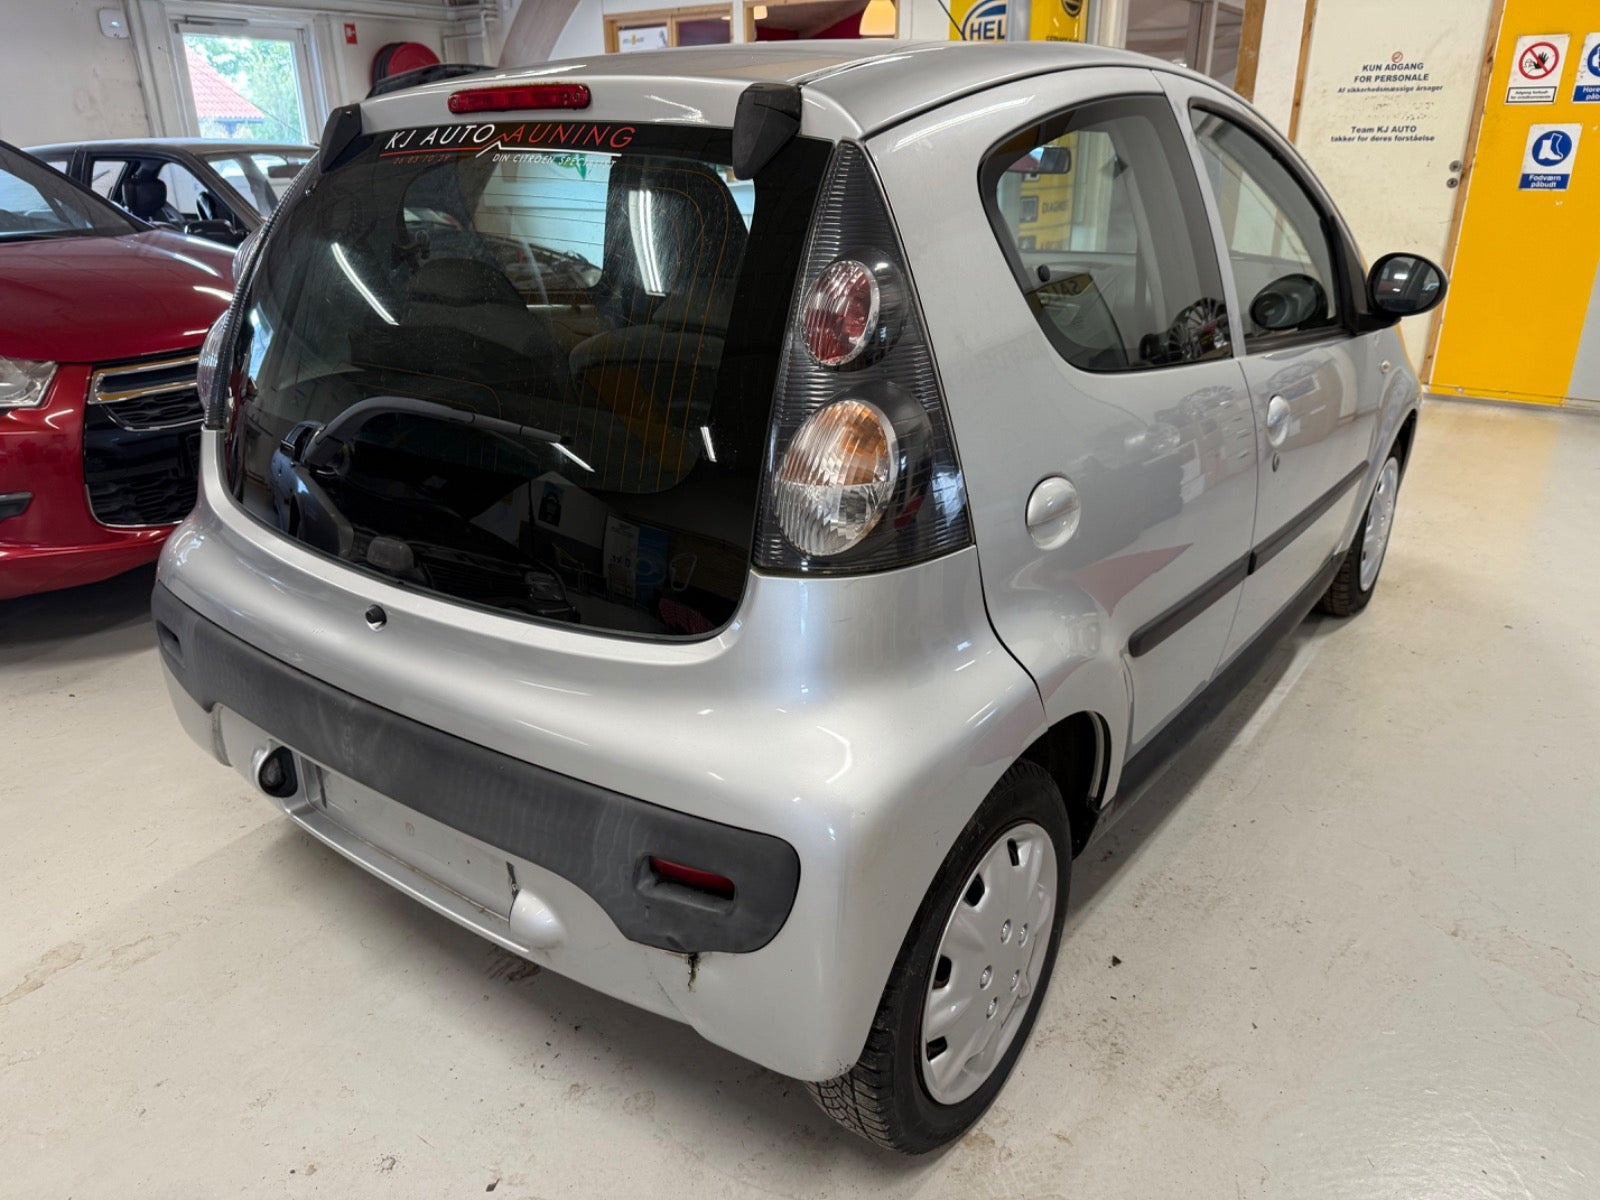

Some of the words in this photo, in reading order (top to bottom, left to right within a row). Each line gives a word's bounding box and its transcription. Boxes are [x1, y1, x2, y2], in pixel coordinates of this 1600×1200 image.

[1362, 64, 1382, 72] KUN
[1384, 62, 1424, 71] ADGANG
[1354, 75, 1372, 83] FOR
[1374, 73, 1430, 82] PERSONALE
[1351, 126, 1374, 134] Team
[1376, 125, 1389, 133] KJ
[1391, 125, 1417, 133] AUTO
[384, 129, 417, 150] KJ
[419, 123, 496, 146] AUTO
[505, 123, 636, 149] AUNING
[1394, 134, 1435, 142] forståelse
[492, 153, 511, 162] DIN
